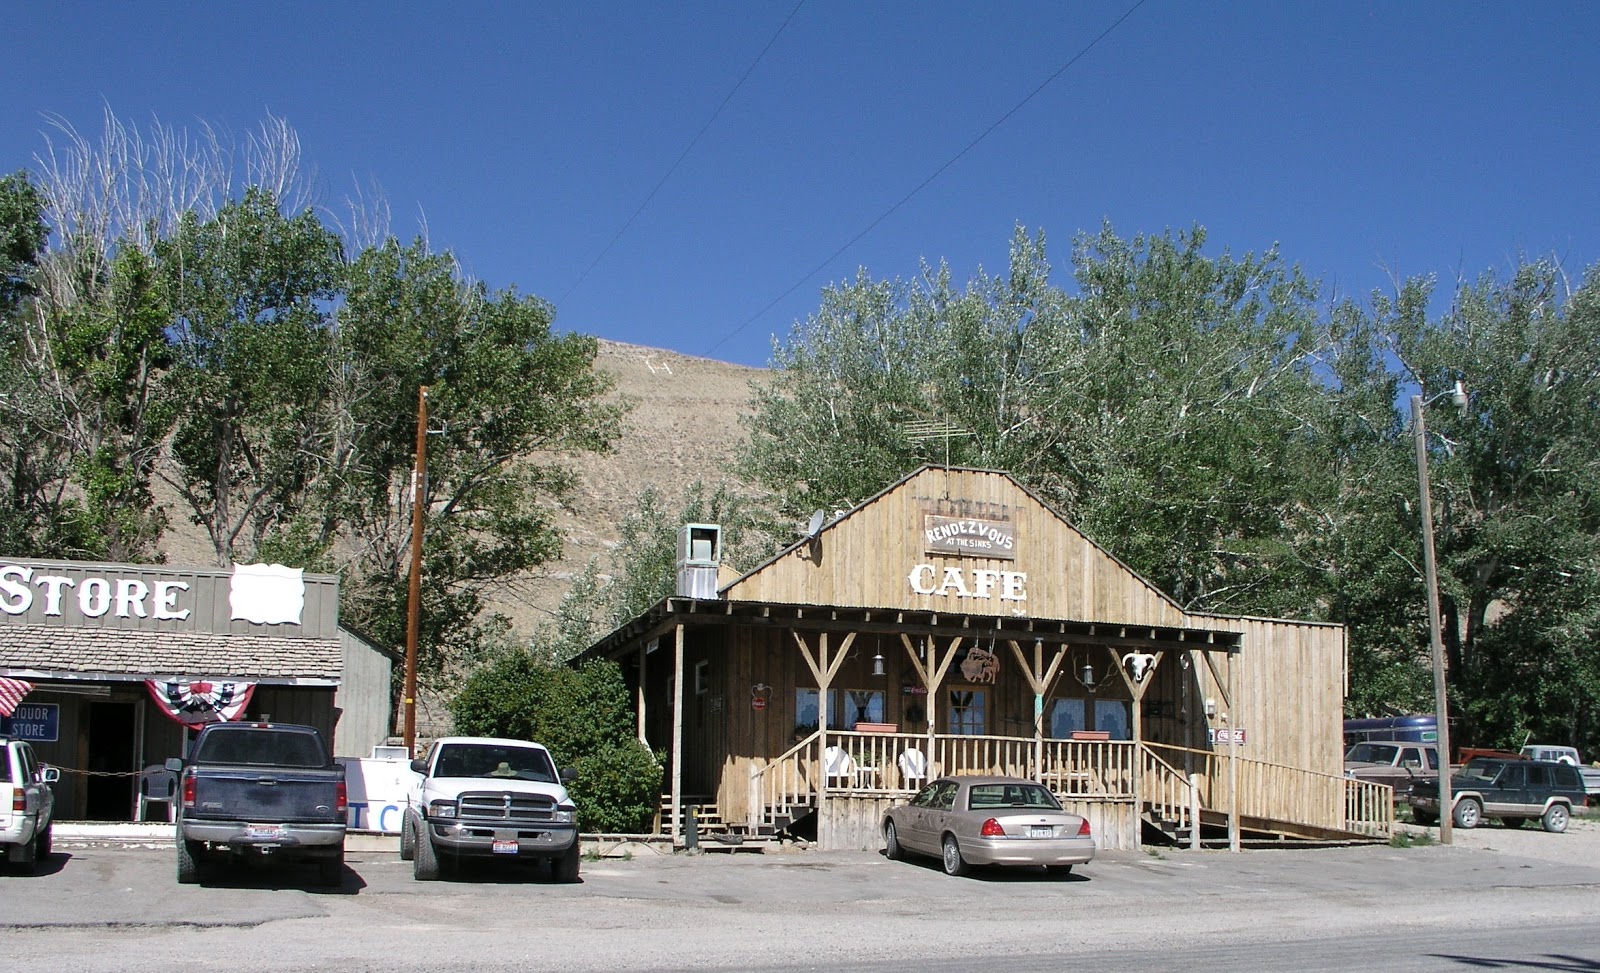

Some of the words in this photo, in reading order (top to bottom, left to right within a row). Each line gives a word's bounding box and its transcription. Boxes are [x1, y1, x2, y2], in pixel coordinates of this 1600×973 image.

[925, 521, 1014, 550] RENDEZVOUS
[946, 538, 955, 546] AT
[956, 538, 968, 547] THE
[969, 539, 992, 549] SINKS
[0, 565, 190, 620] STORE
[908, 563, 1027, 601] CAFE
[10, 707, 49, 720] LIQUOR
[12, 723, 45, 737] STORE
